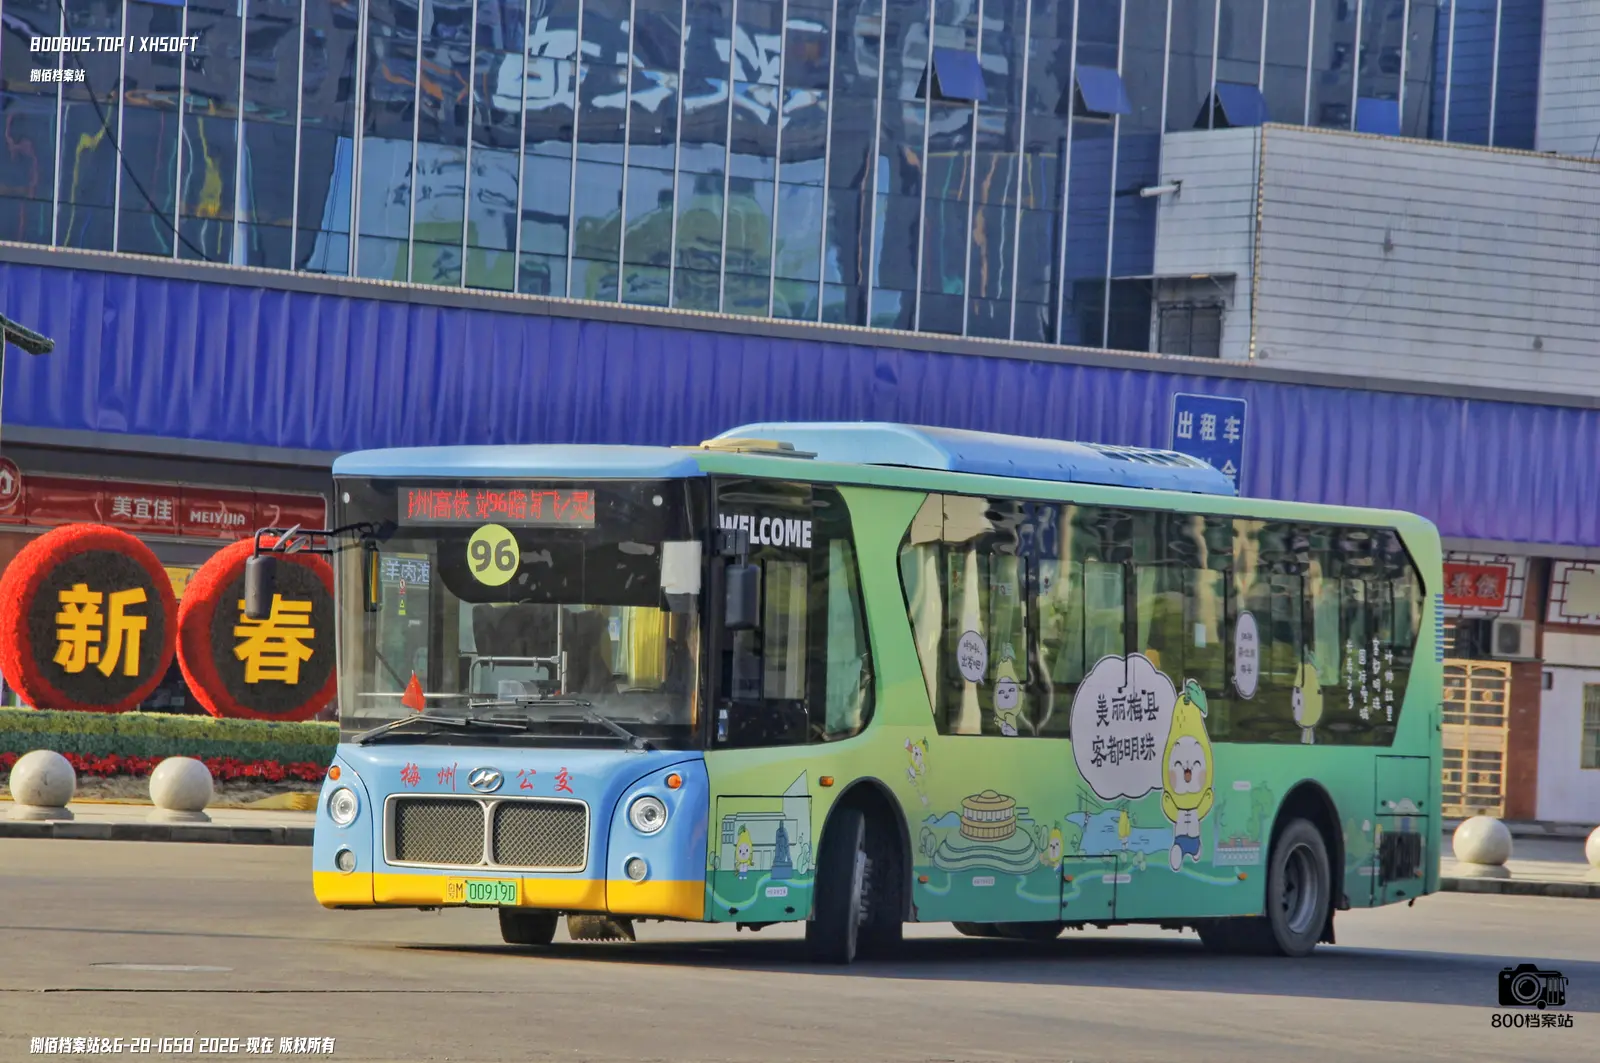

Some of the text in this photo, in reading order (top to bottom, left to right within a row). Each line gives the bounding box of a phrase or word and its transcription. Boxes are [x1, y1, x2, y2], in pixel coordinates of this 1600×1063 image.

[1177, 410, 1241, 444] 出租车
[112, 496, 172, 521] 美宜佳
[190, 510, 246, 526] MEIYIJIA
[470, 538, 516, 572] 96
[53, 583, 315, 685] 新 春
[1096, 691, 1160, 728] 美丽梅县
[1090, 732, 1157, 768] 客都明珠
[515, 766, 574, 794] 公交
